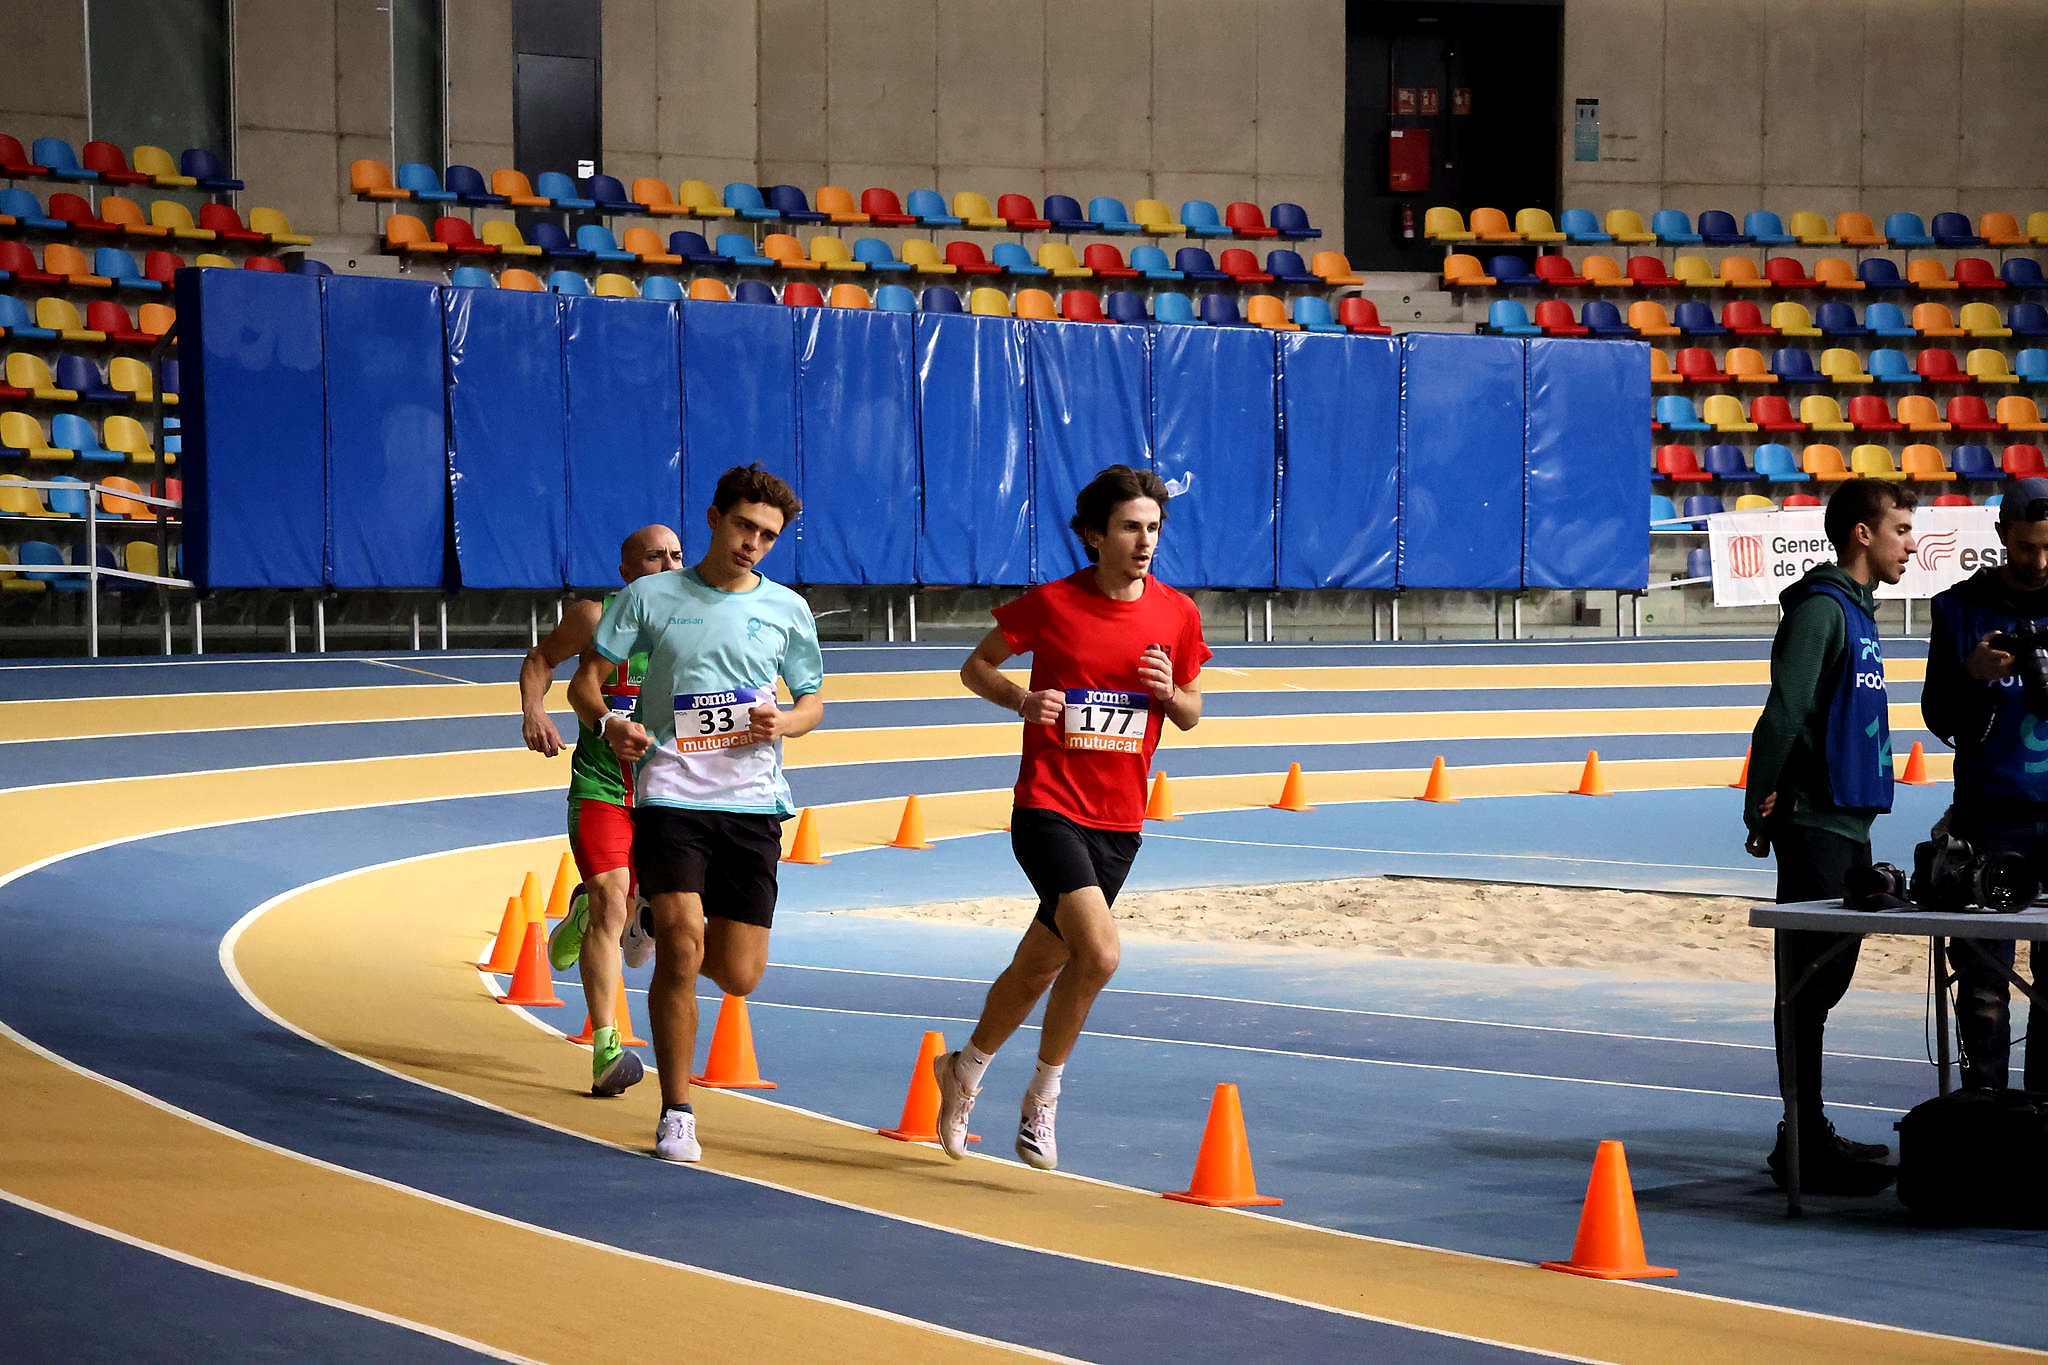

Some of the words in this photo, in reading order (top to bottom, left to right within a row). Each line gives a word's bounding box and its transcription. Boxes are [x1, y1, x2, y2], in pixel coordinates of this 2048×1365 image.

[1774, 560, 1796, 577] de
[698, 707, 735, 735] 33
[1079, 706, 1134, 734] 177
[682, 733, 753, 752] mutuacat
[1069, 735, 1138, 752] mutuacat
